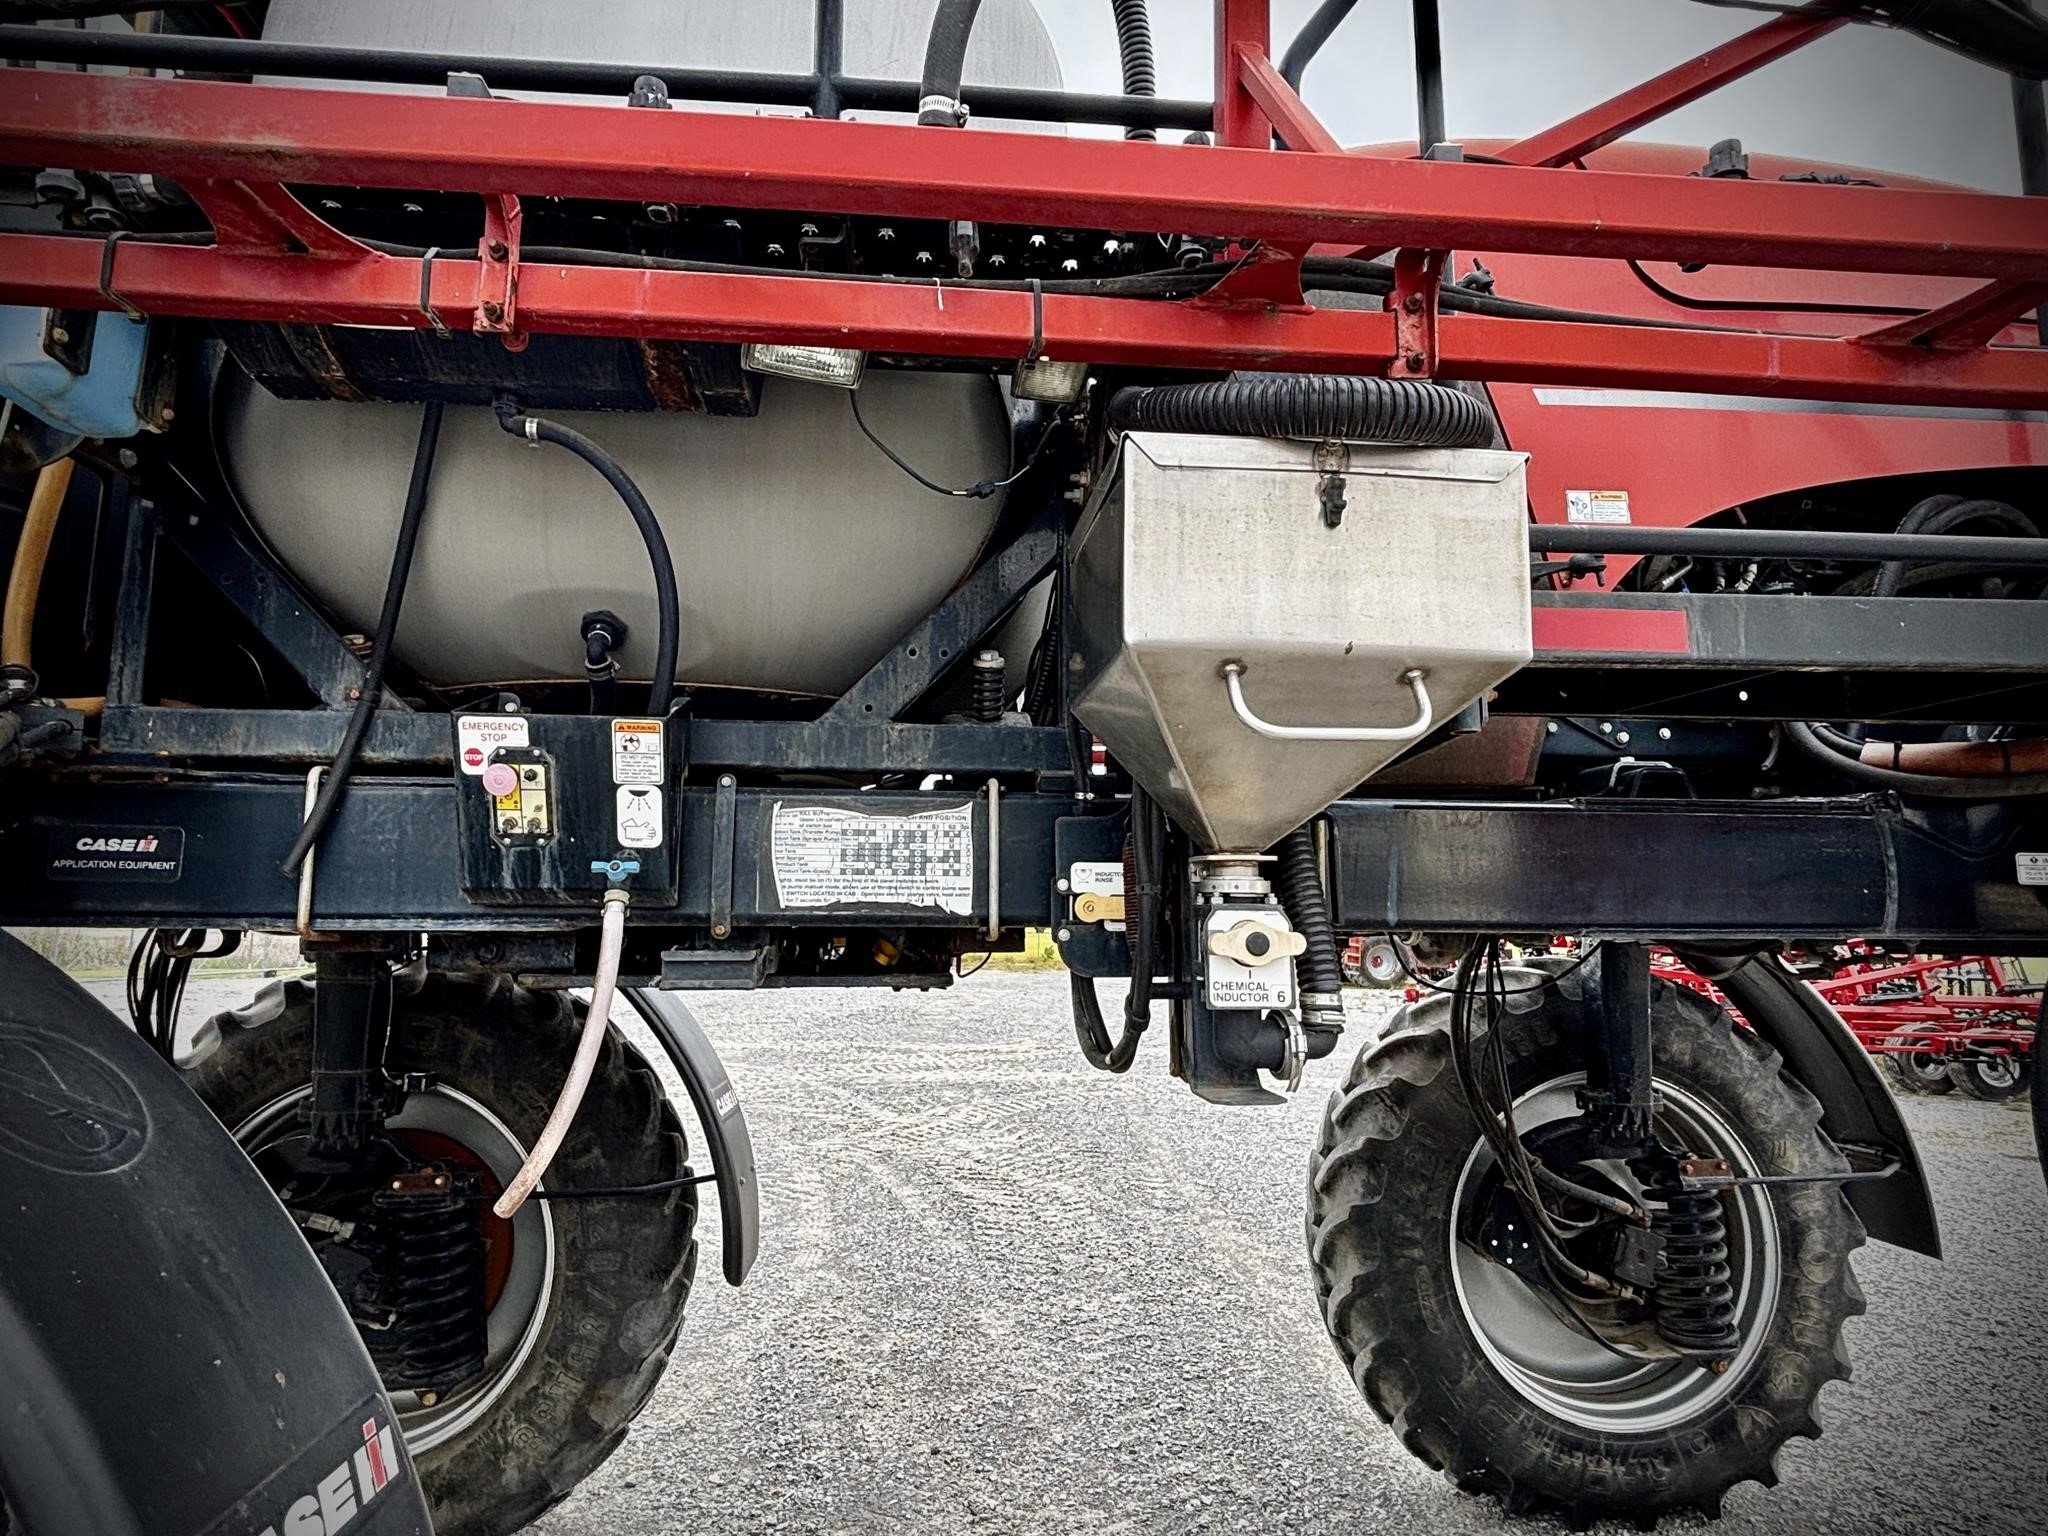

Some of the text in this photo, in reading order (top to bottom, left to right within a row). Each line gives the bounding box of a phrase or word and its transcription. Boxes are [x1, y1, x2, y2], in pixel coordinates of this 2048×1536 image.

[462, 722, 524, 731] EMERGENCY
[480, 732, 508, 742] STOP
[464, 753, 484, 761] STOP
[76, 838, 137, 851] CASE
[53, 859, 176, 870] APPLICATION EQUIPMENT
[1212, 981, 1269, 992] CHEMICAL
[1213, 992, 1269, 1003] INDUCTOR
[1277, 991, 1286, 1003] 6
